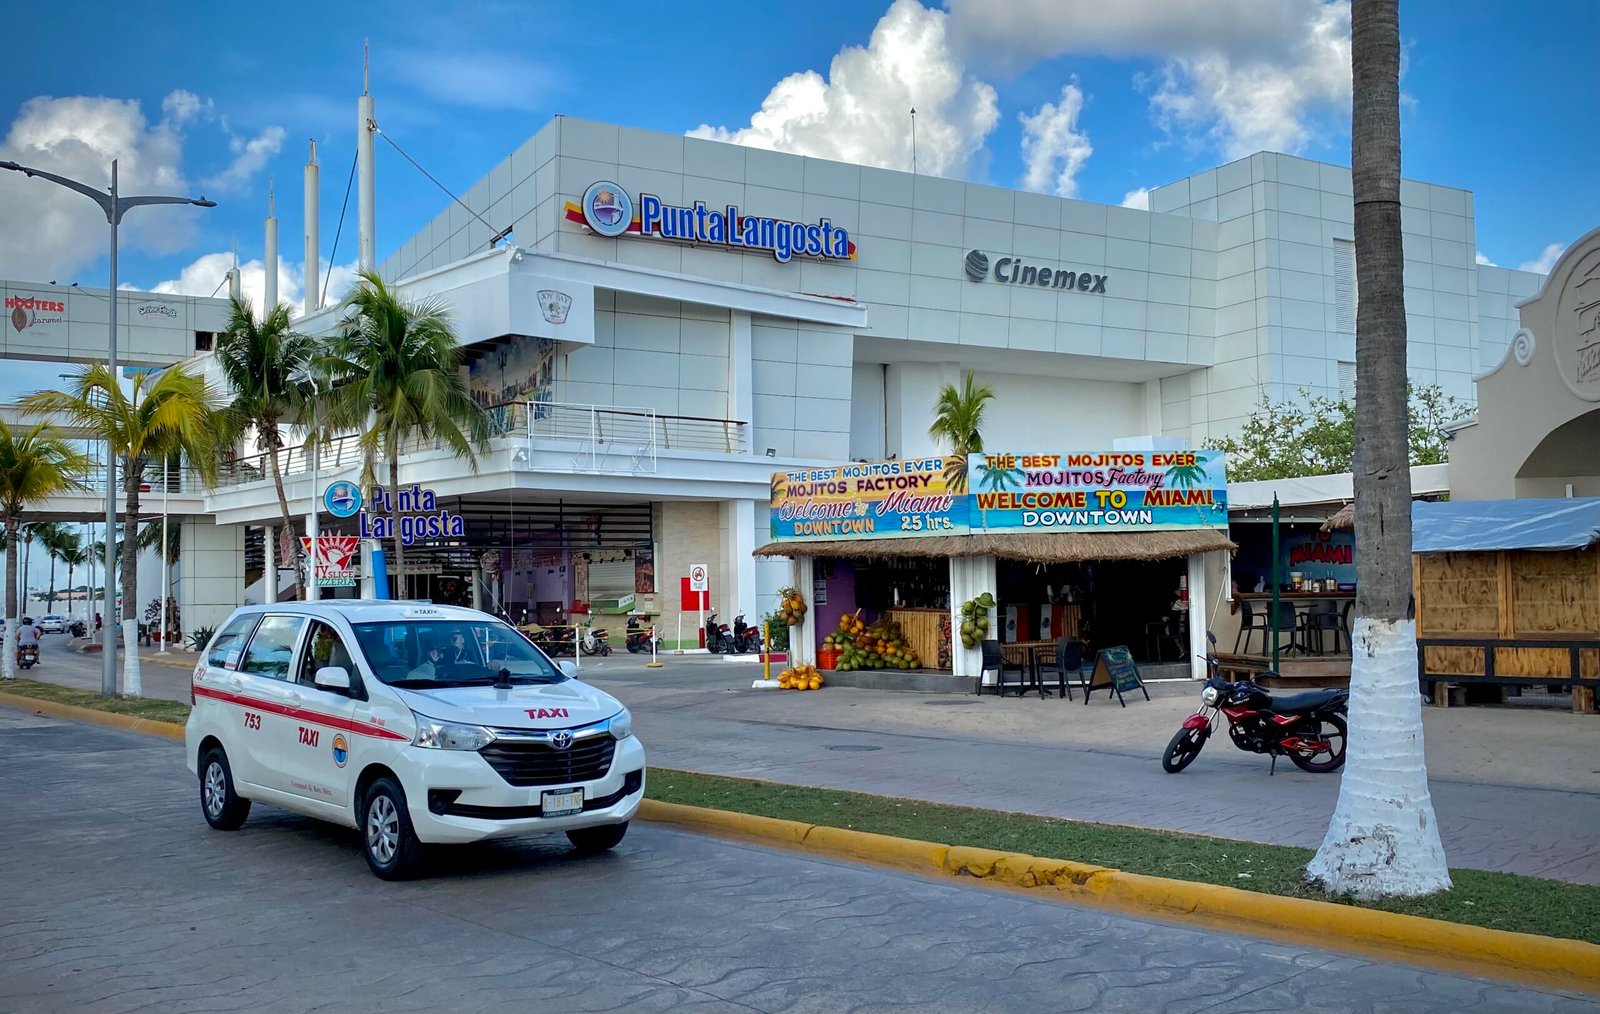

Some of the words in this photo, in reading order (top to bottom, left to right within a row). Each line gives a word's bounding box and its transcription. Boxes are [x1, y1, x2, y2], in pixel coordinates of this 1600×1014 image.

[994, 257, 1108, 293] Cinemex
[5, 298, 64, 312] HOOTERS
[787, 472, 807, 483] THE
[810, 469, 838, 481] BEST
[842, 463, 900, 478] MOJITOS
[904, 458, 943, 473] EVER
[985, 454, 1015, 469] THE
[1022, 455, 1061, 468] BEST
[1067, 454, 1145, 467] MOJITOS
[1152, 453, 1196, 466] EVER
[786, 481, 847, 498] MOJITOS
[857, 474, 932, 492] FACTORY
[1026, 471, 1104, 487] MOJITOS
[1103, 467, 1165, 491] Factory
[370, 484, 437, 513] Punta
[779, 498, 852, 521] Welcome
[851, 499, 869, 517] to
[876, 490, 954, 516] Miami
[977, 489, 1086, 509] WELCOME
[1095, 490, 1126, 508] TO
[1143, 489, 1214, 507] MIAMI
[794, 518, 874, 536] DOWNTOWN
[901, 516, 923, 531] 25
[926, 515, 954, 531] hrs.
[1022, 510, 1153, 527] DOWNTOWN
[1290, 543, 1352, 567] MIAMI
[328, 570, 354, 578] SLICE
[244, 712, 261, 731] 753
[524, 708, 569, 719] TAXI
[298, 727, 320, 748] TAXI
